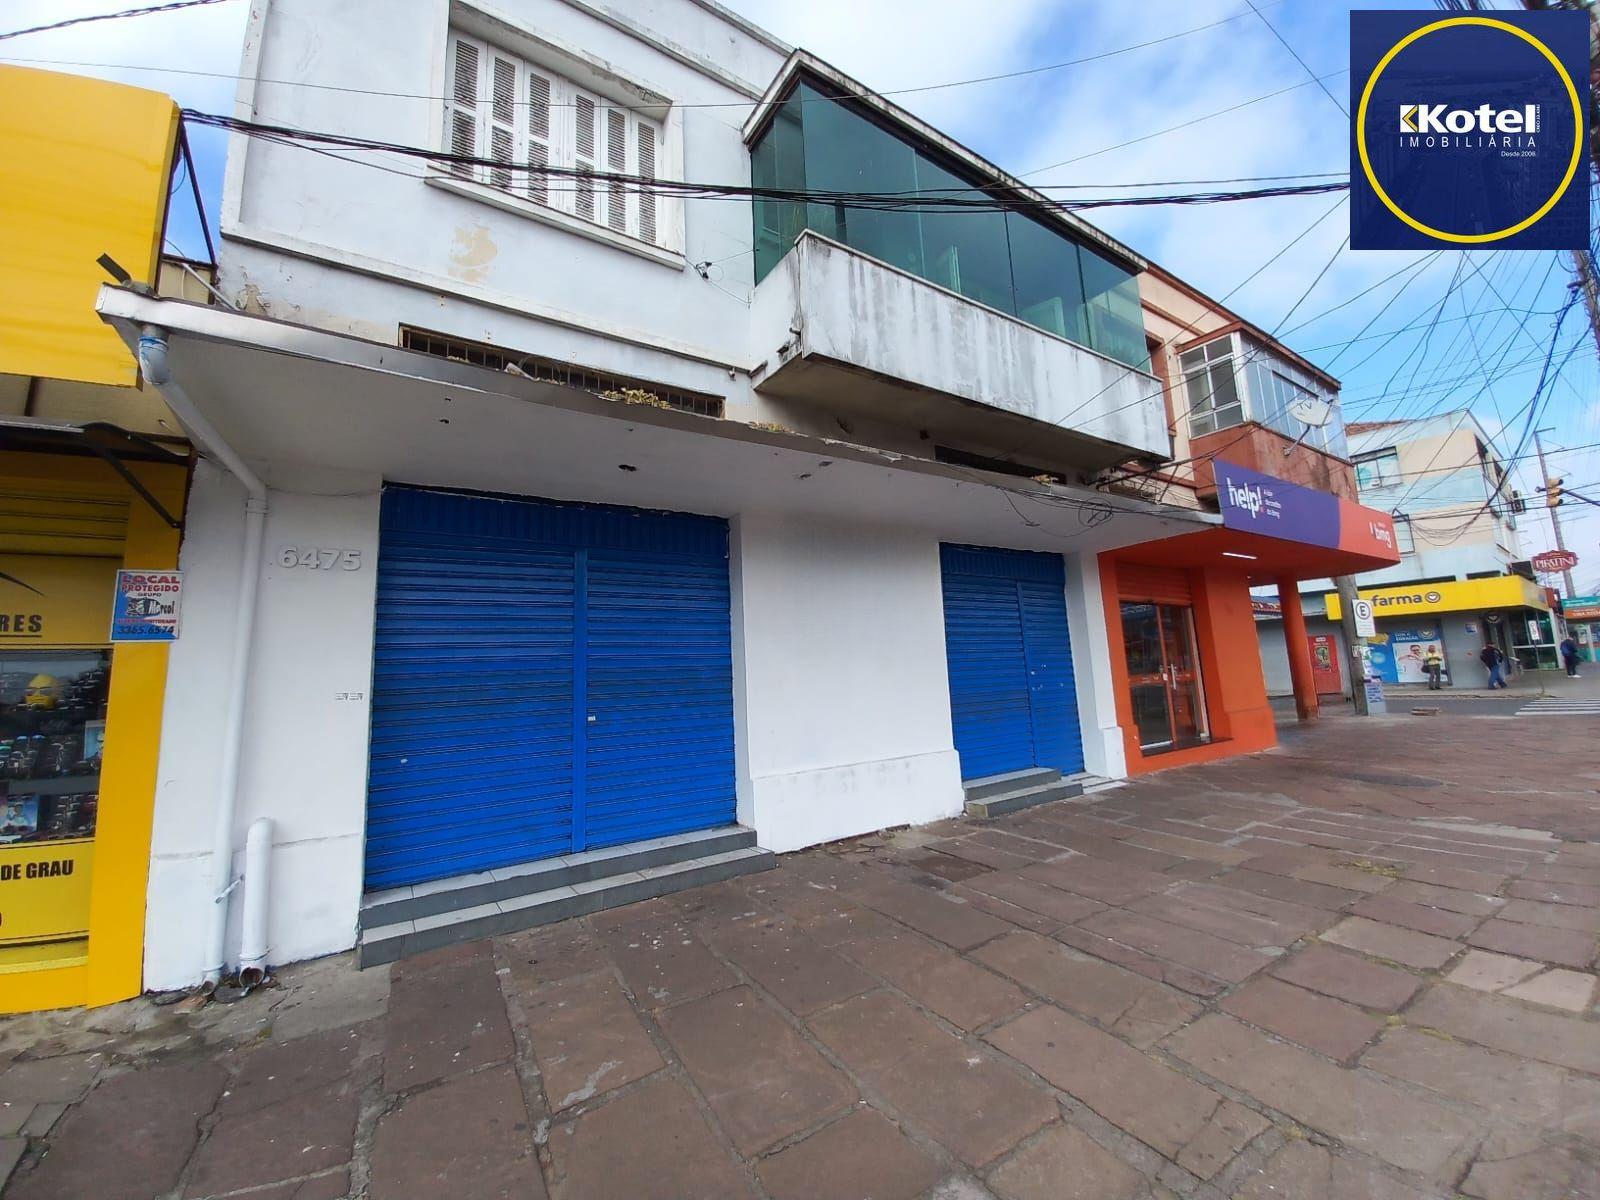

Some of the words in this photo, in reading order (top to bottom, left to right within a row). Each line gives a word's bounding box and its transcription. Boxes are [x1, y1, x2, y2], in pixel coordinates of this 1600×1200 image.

[1226, 477, 1262, 519] help!
[279, 547, 362, 572] 6475
[122, 575, 180, 584] LOCAL
[122, 584, 179, 592] PROTEGIDO
[0, 864, 22, 881] DE
[26, 859, 74, 879] GRAU
